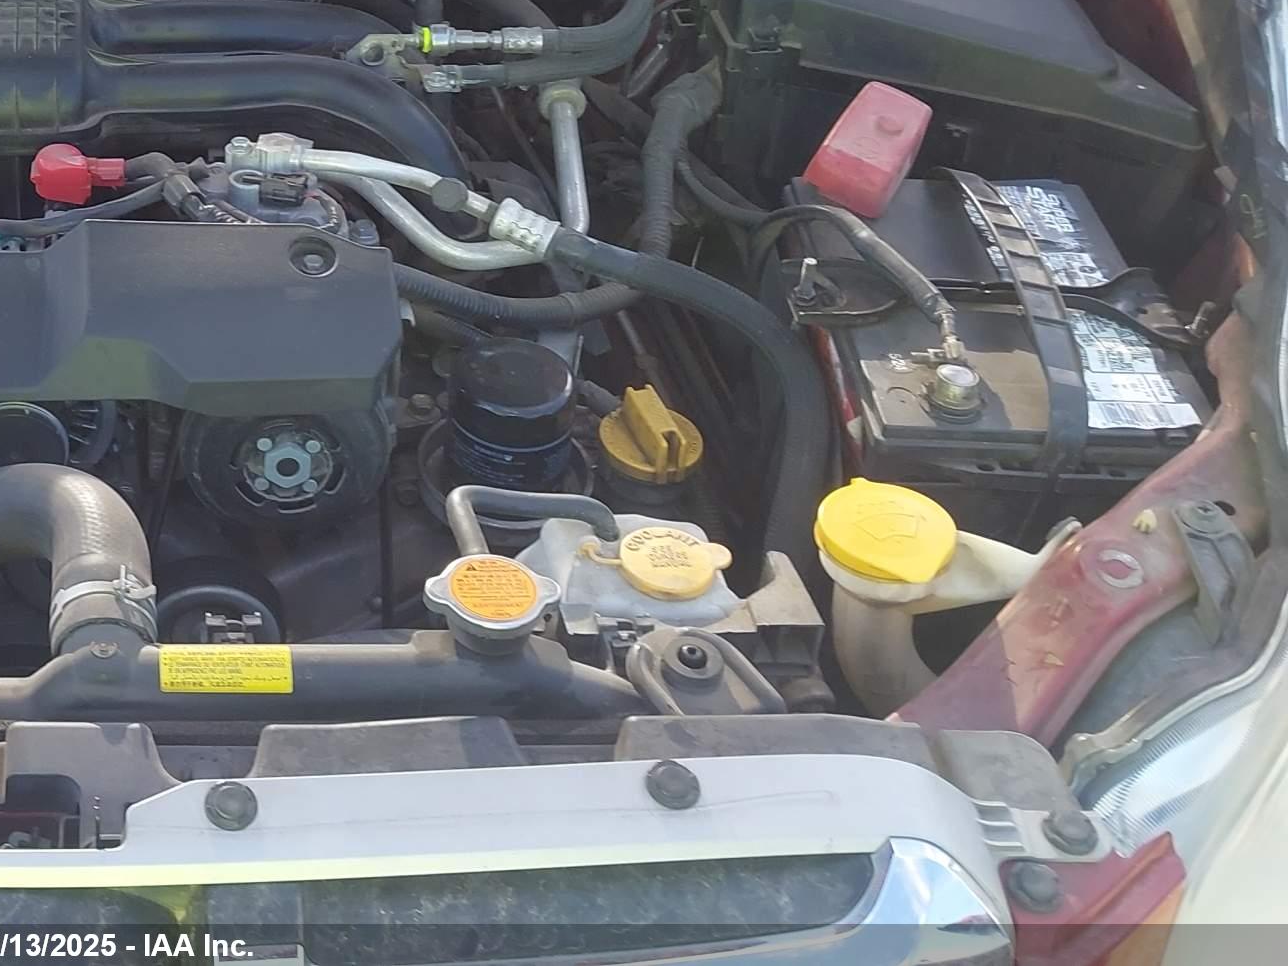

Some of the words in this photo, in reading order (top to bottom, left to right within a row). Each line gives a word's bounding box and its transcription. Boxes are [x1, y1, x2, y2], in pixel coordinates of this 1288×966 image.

[1025, 185, 1063, 232] START
[1046, 193, 1074, 233] SUPER
[625, 530, 700, 551] COOLANT
